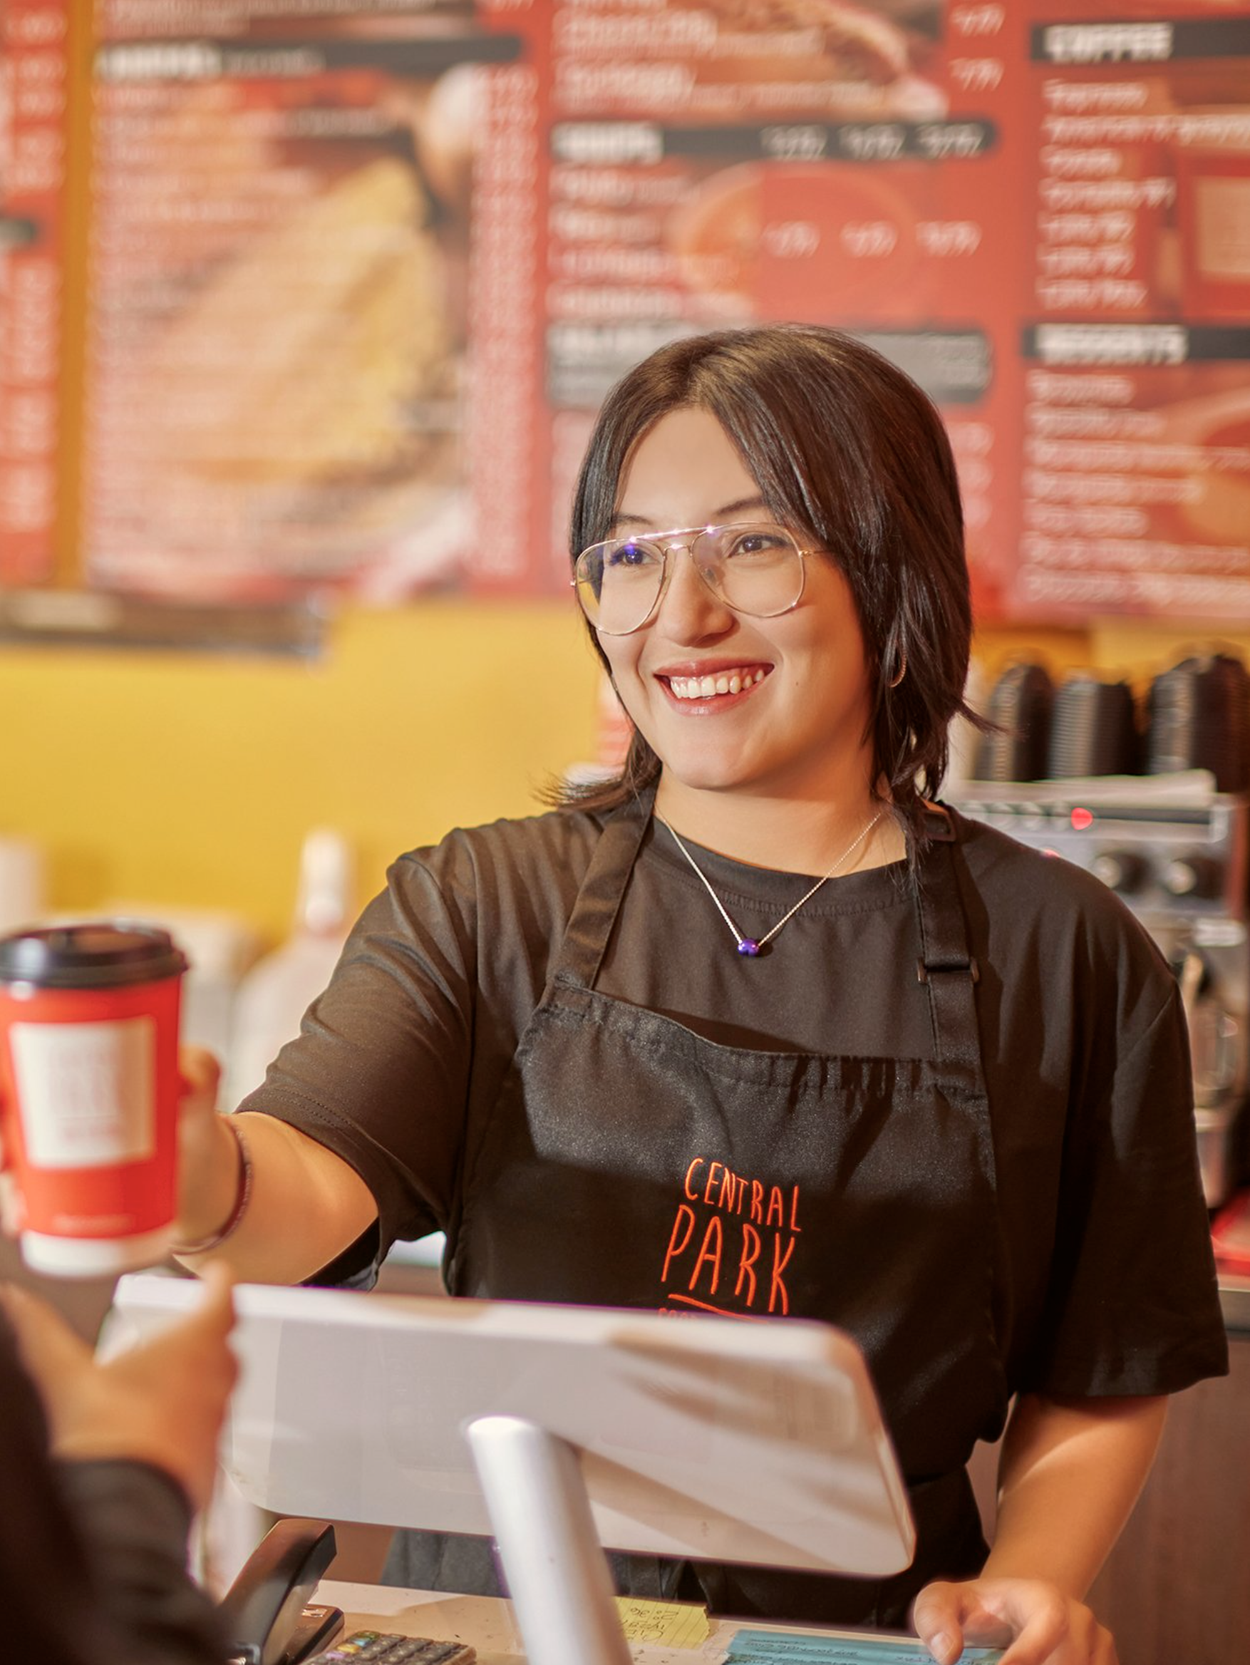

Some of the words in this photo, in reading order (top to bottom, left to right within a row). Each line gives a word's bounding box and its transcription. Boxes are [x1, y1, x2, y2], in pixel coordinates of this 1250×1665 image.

[1046, 23, 1173, 62] COFFEE
[1036, 322, 1188, 366] DESSERTS
[684, 1158, 801, 1231] CENTRAL
[661, 1204, 795, 1315] PARK
